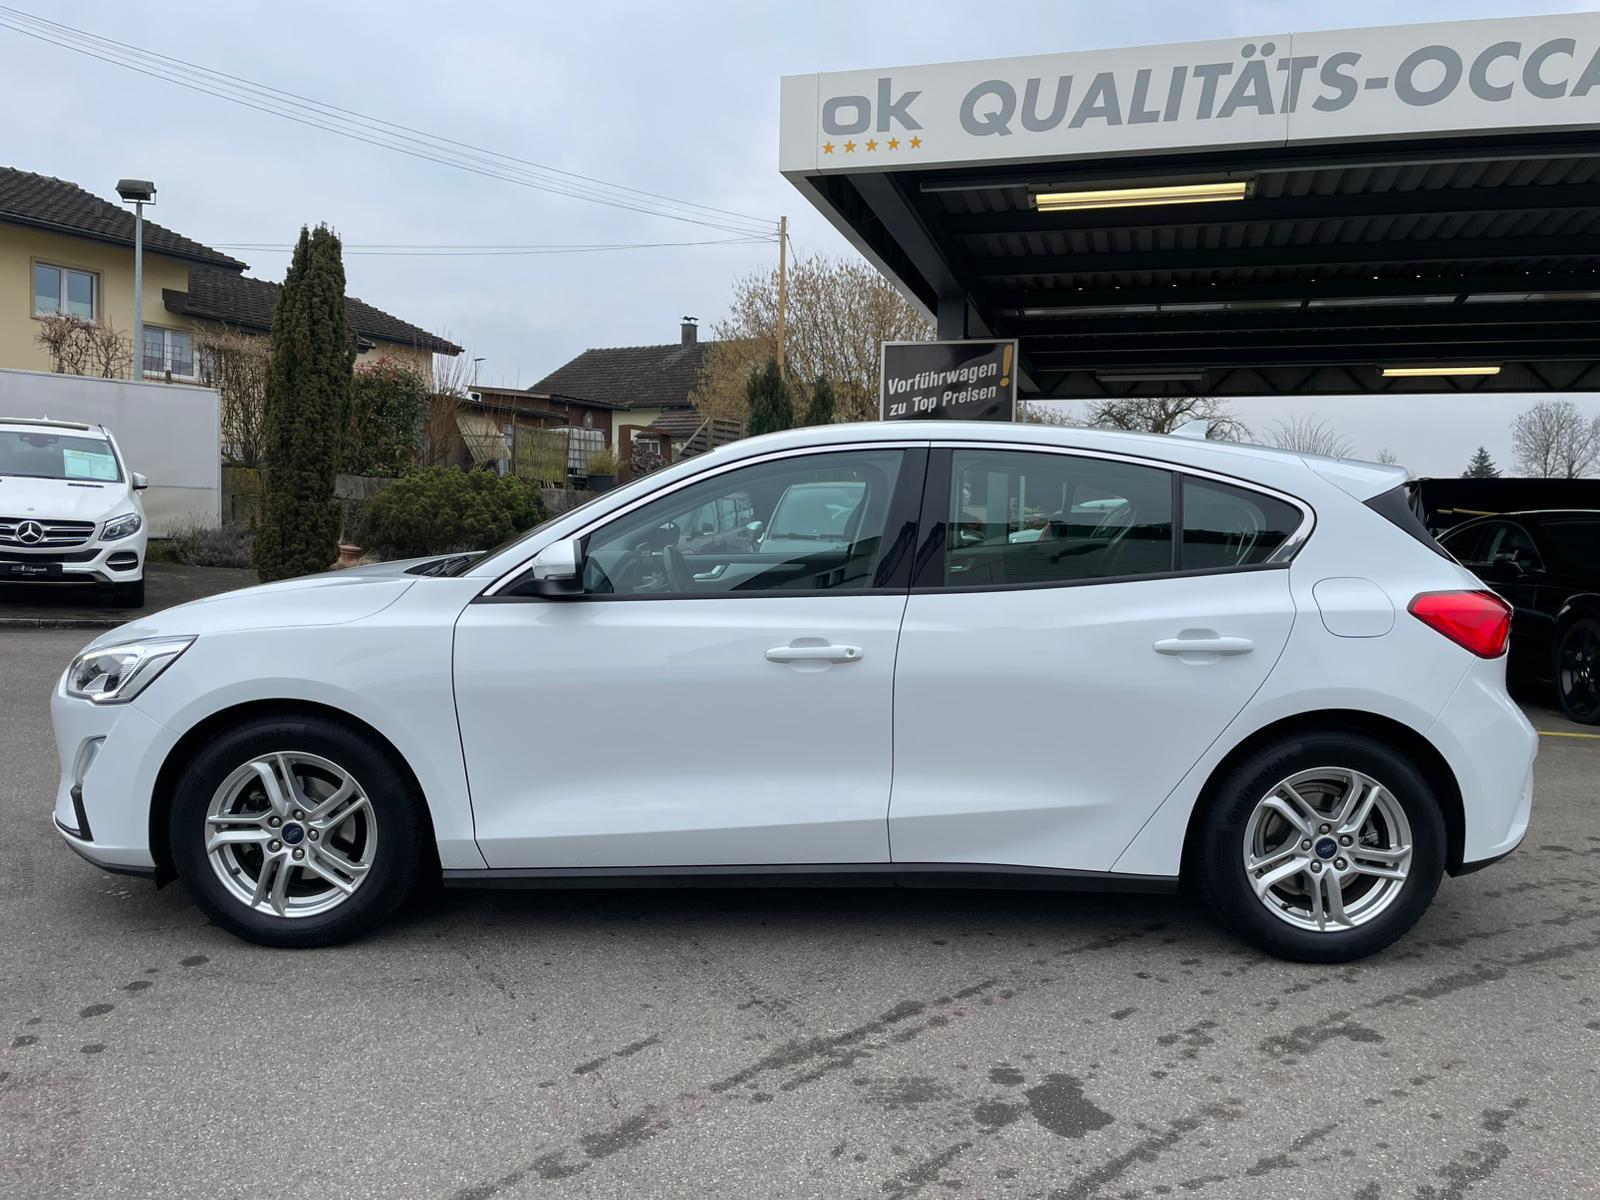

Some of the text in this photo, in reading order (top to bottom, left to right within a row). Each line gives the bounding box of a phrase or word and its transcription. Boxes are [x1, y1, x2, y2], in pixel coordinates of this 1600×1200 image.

[822, 77, 923, 135] ok
[887, 362, 998, 395] Vorführwagen
[889, 402, 907, 416] zu
[912, 396, 938, 413] Top
[942, 385, 997, 407] Preisen
